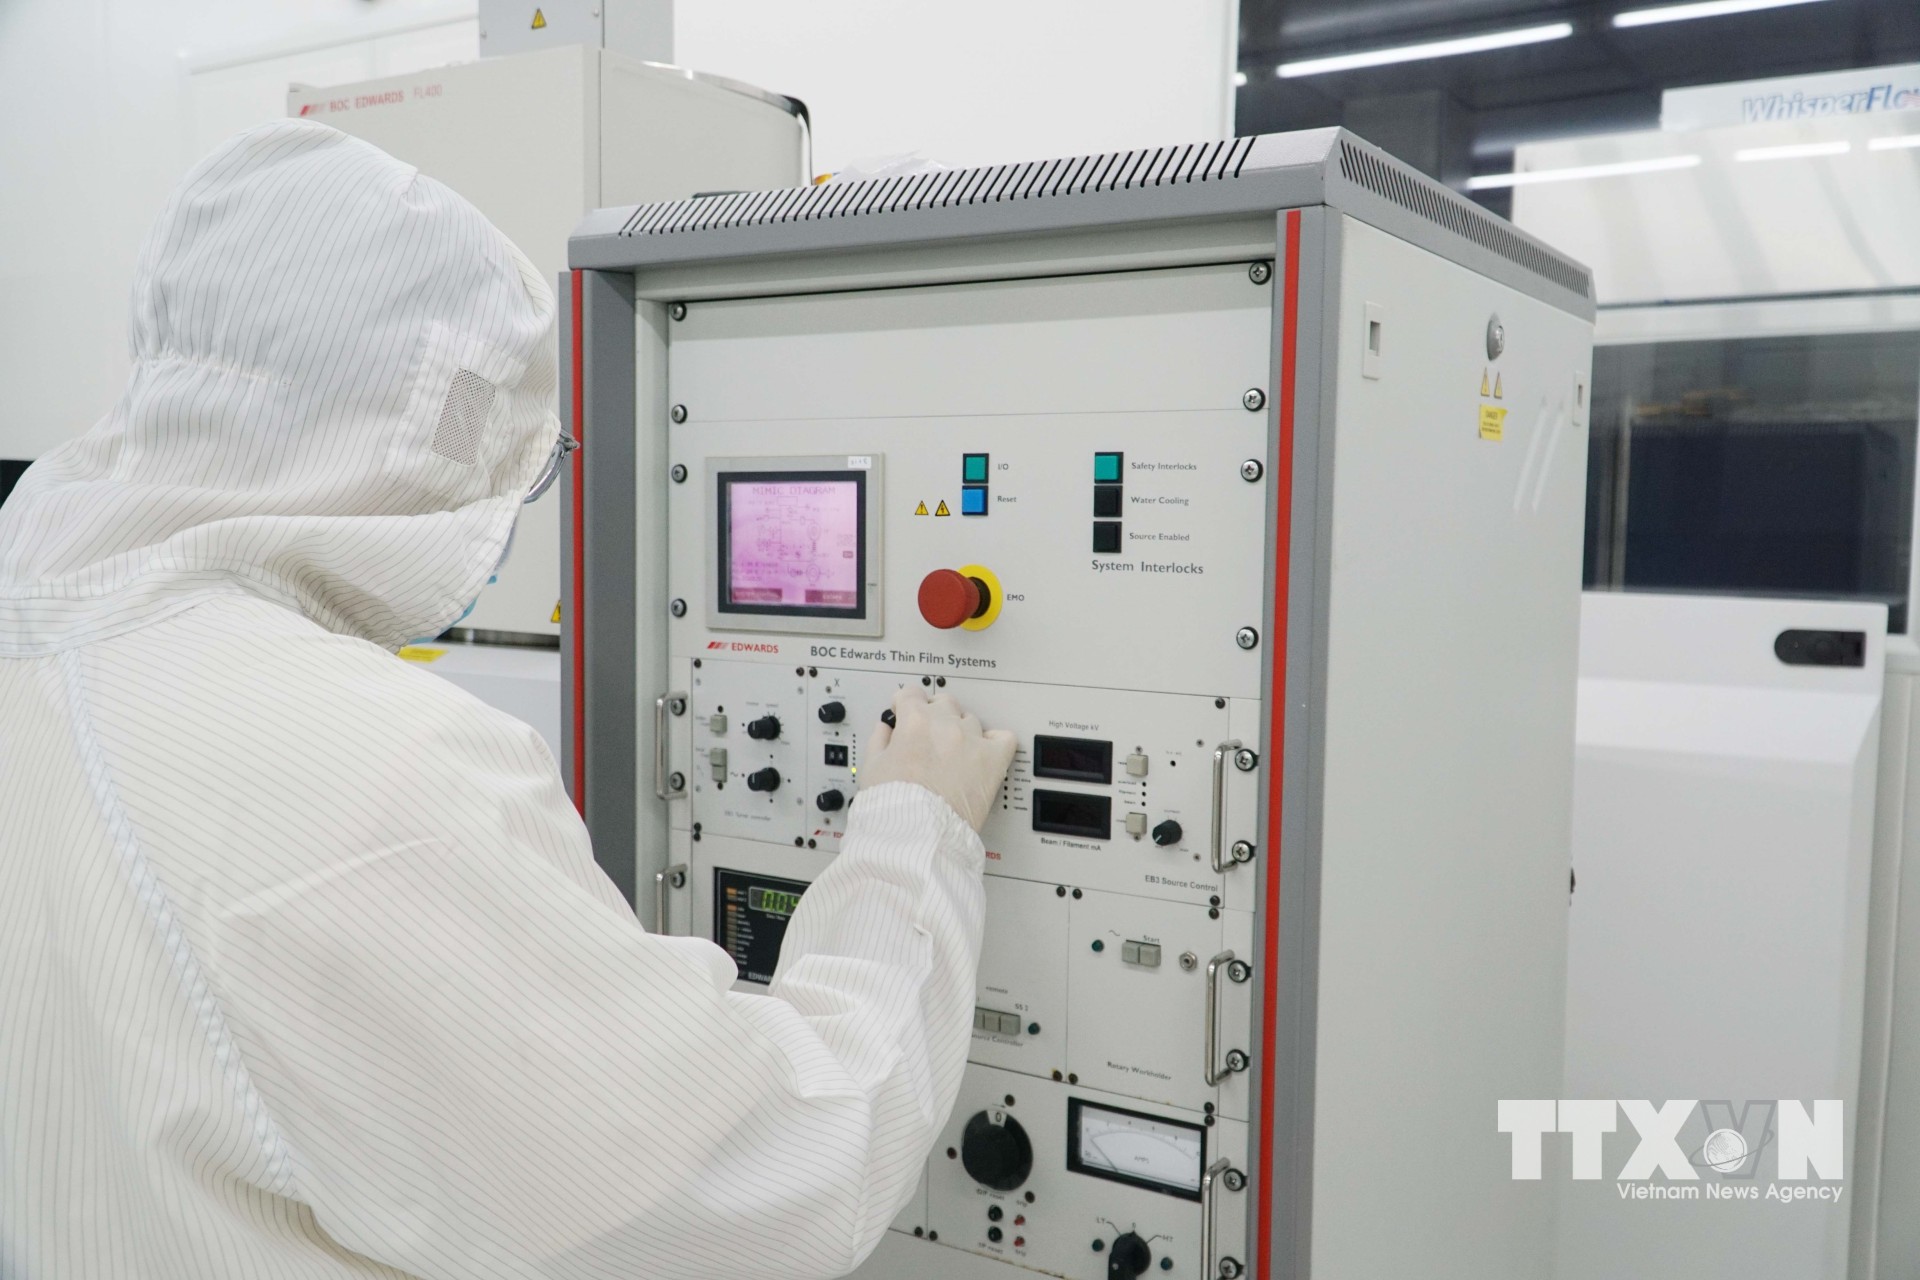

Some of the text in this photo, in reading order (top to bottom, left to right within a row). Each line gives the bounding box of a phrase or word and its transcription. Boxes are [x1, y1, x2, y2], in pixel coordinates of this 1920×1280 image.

[330, 84, 443, 112] BOC EDWARDS FL400
[1742, 84, 1920, 123] WhisperFlo
[997, 463, 1009, 471] I/O
[1131, 462, 1155, 471] Safety
[752, 486, 836, 495] MIMIC DIAGRAM
[997, 495, 1017, 503] Reset
[1130, 496, 1189, 506] Water Cooling
[1129, 532, 1190, 541] Source Enabled
[1092, 560, 1204, 575] System Interlocks
[1006, 594, 1025, 602] EMO
[731, 642, 779, 654] EDWARDS
[810, 646, 997, 669] BOC Edwards Thin Film Systems
[1049, 720, 1064, 729] High
[1065, 722, 1089, 732] Voltage
[1041, 837, 1058, 847] Beam
[1063, 840, 1090, 850] Filament
[1090, 843, 1102, 851] mA
[1145, 874, 1218, 893] EB3 Source Control
[1143, 934, 1161, 943] Start
[748, 971, 773, 981] EDWA
[1107, 1061, 1172, 1081] Rotary Workholder
[995, 1111, 1003, 1123] 0
